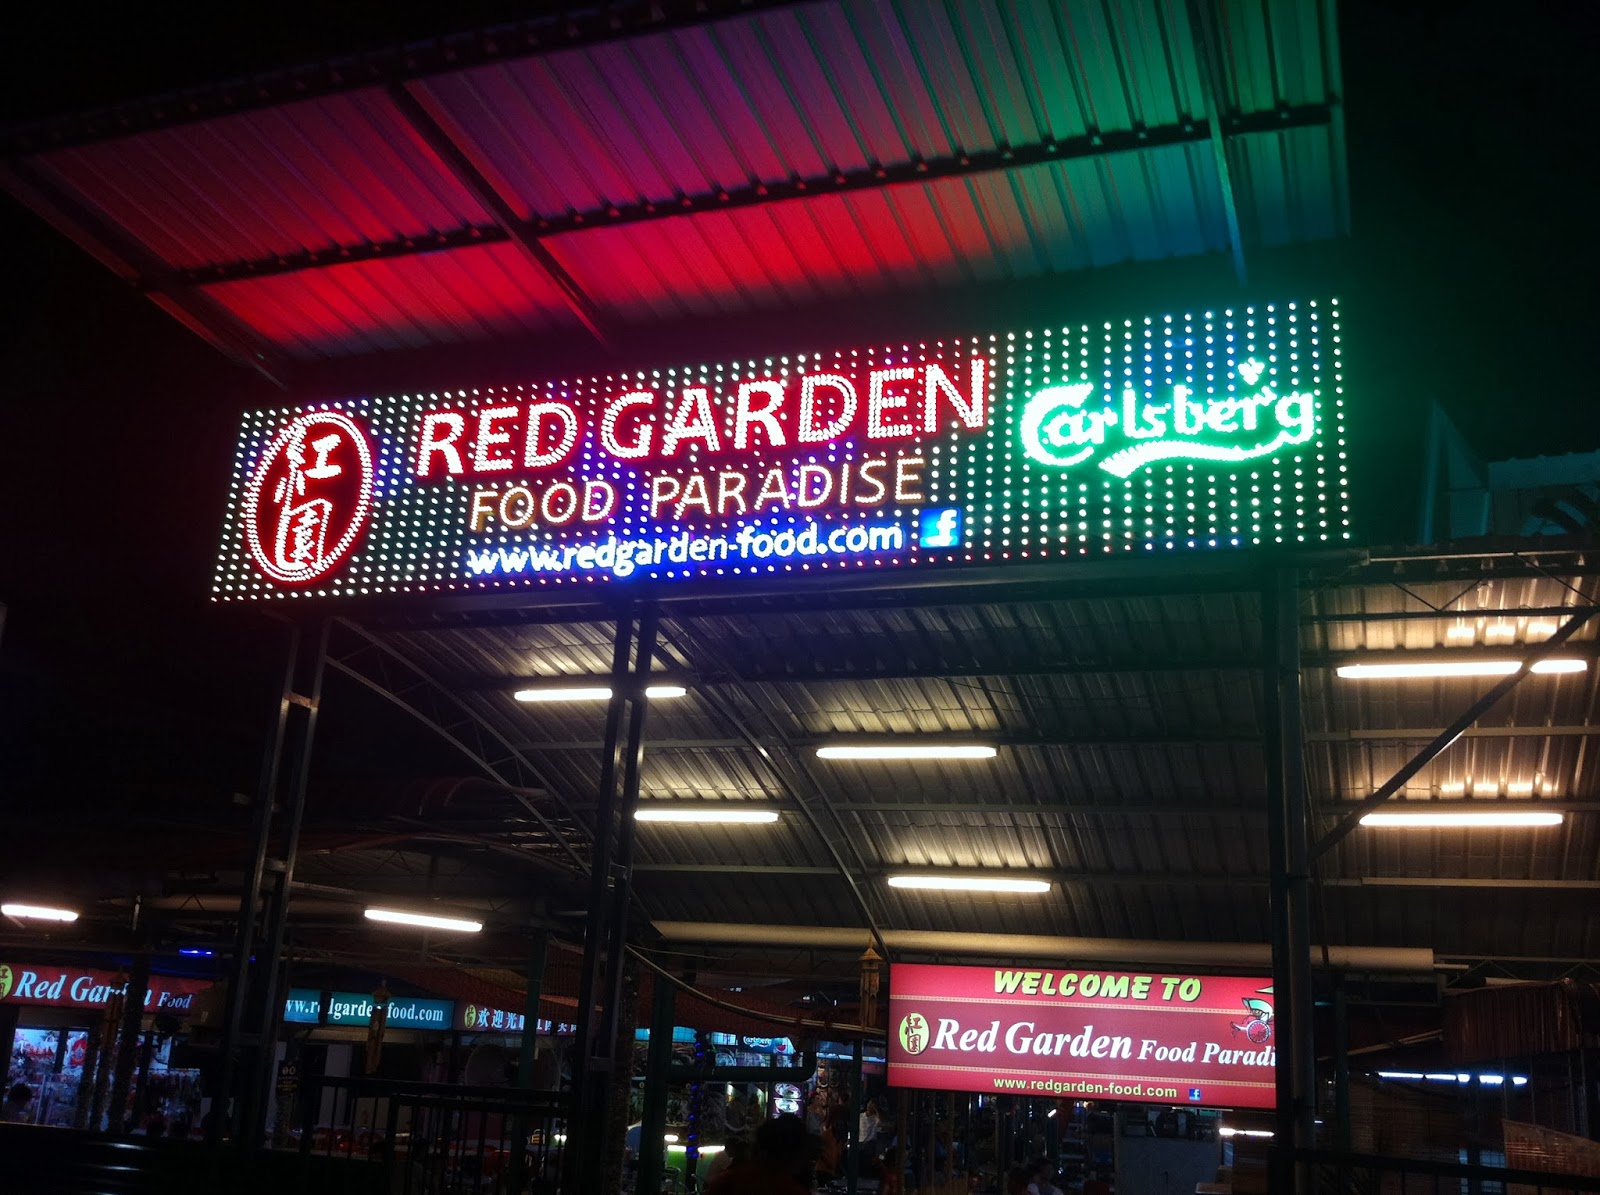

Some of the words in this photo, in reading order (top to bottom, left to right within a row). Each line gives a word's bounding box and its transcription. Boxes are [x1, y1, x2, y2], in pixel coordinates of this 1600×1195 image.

[416, 402, 577, 478] RED
[600, 358, 986, 460] GARDEN
[1020, 380, 1315, 477] Carlsberg
[469, 480, 617, 532] FOOD
[650, 456, 926, 520] PARADISE
[467, 522, 905, 577] www.redgarden-food.com
[12, 971, 67, 1000] Red
[70, 976, 152, 1006] Gar
[994, 971, 1152, 1000] WELCOME
[1160, 977, 1202, 1002] TO
[931, 1018, 1000, 1053] Red
[1005, 1021, 1132, 1060] Garden
[1137, 1039, 1197, 1063] Food
[1201, 1042, 1276, 1067] Paradi
[993, 1076, 1178, 1098] www.redgarden-food.com
